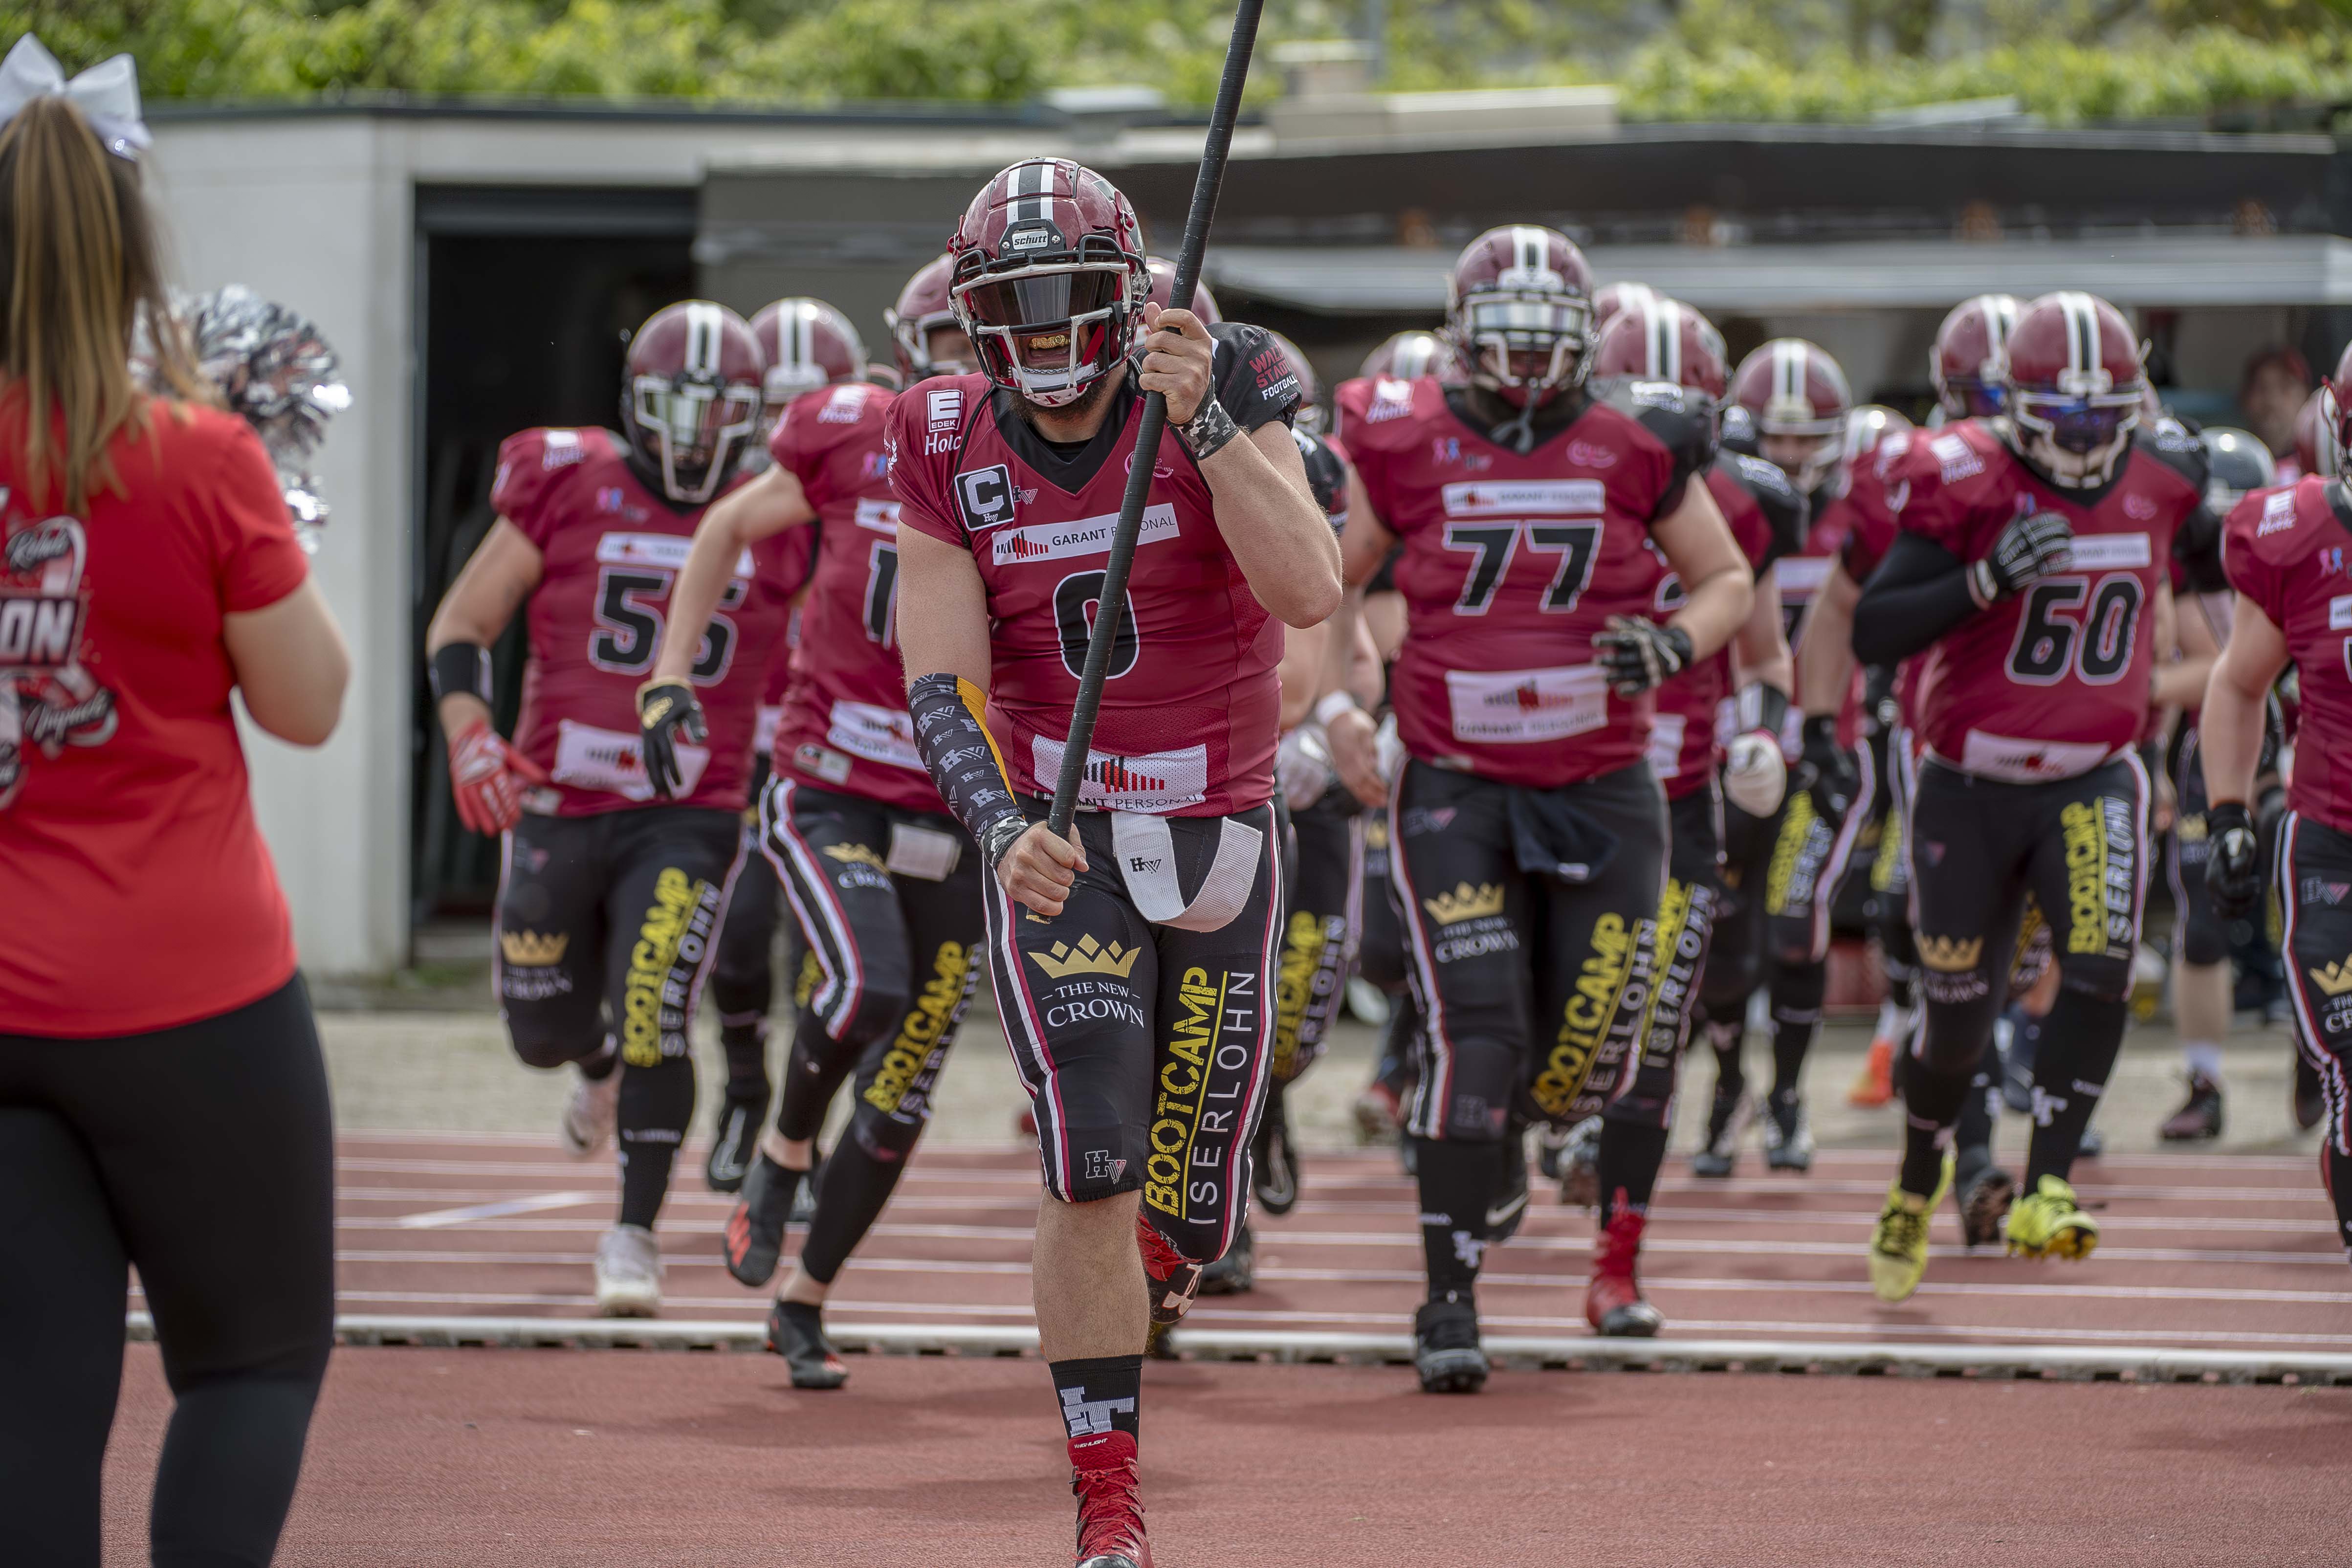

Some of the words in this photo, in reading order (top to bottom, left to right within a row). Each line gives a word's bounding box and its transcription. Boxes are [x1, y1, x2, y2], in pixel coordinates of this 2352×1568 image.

[1014, 235, 1048, 246] schutt
[1261, 374, 1298, 400] FOOTBALL
[965, 470, 1004, 515] C
[1052, 529, 1107, 546] GARANT
[1111, 516, 1175, 537] PONAL
[1442, 518, 1605, 616] 77
[1053, 569, 1140, 681] 0
[2004, 572, 2145, 687] 60
[1115, 793, 1202, 809] PERSONAL
[1055, 982, 1094, 998] THE
[1097, 982, 1129, 998] NEW
[1047, 999, 1144, 1028] CROWN
[1145, 967, 1217, 1217] BOOTCAMP
[1188, 972, 1255, 1224] ISERLOHN
